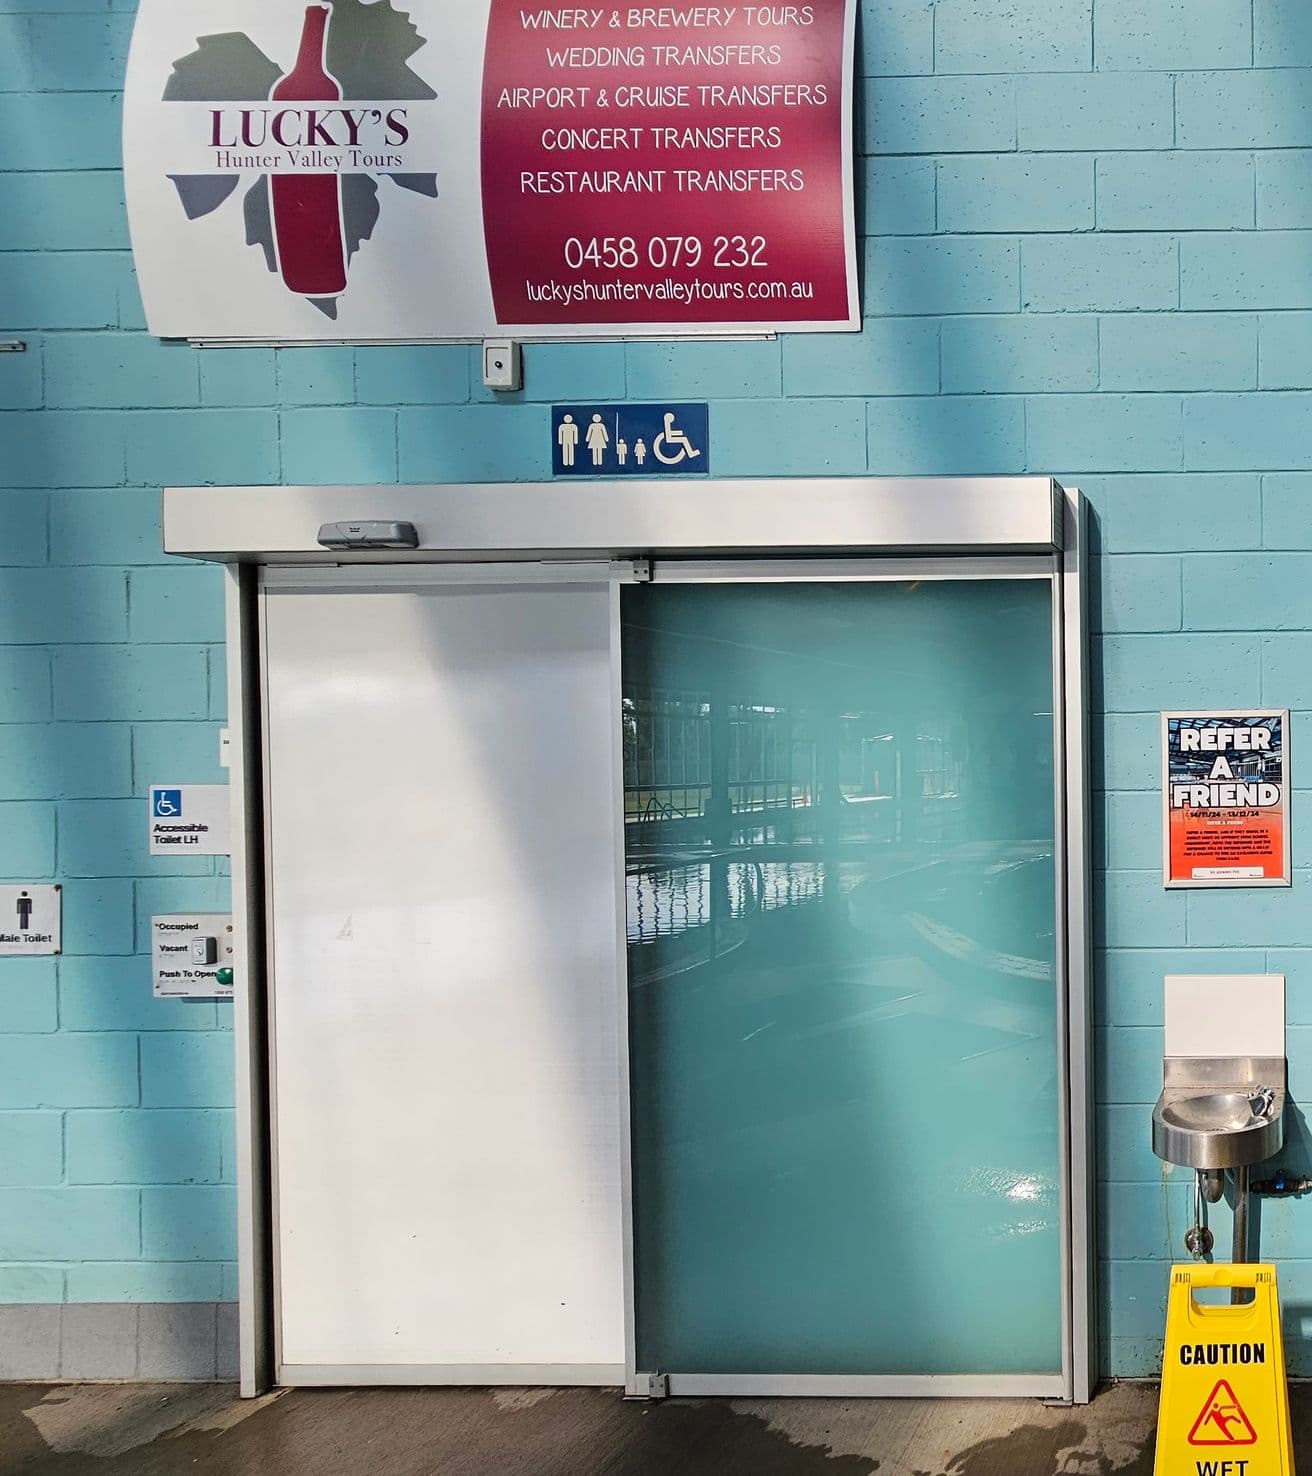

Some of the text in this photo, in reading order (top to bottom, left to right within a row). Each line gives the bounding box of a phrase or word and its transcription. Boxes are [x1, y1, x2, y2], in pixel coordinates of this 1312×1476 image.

[520, 6, 814, 29] WINERY & BREWERY TOURS
[546, 44, 782, 67] WEDDING TRANSFERS
[497, 84, 828, 108] AIRPORT & CRUISE TRANSFERS
[207, 108, 409, 148] LUCKY’S
[542, 126, 781, 150] CONCERT TRANSFERS
[216, 150, 402, 172] Hunter Valley Tours
[520, 169, 805, 193] RESTAURANT TRANSFERS
[564, 235, 768, 268] 0458 079 232
[526, 278, 814, 306] luckyshuntervalleytours.com.au
[1179, 727, 1271, 752] REFER
[1209, 755, 1235, 779] A
[1173, 783, 1281, 808] FRIEND
[153, 823, 209, 832] Accessible
[153, 835, 199, 844] Toilet LH
[22, 932, 52, 942] Toilet
[159, 922, 199, 931] Occupied
[194, 970, 217, 978] Open
[1179, 1343, 1265, 1365] CAUTION
[1196, 1460, 1249, 1476] WET
